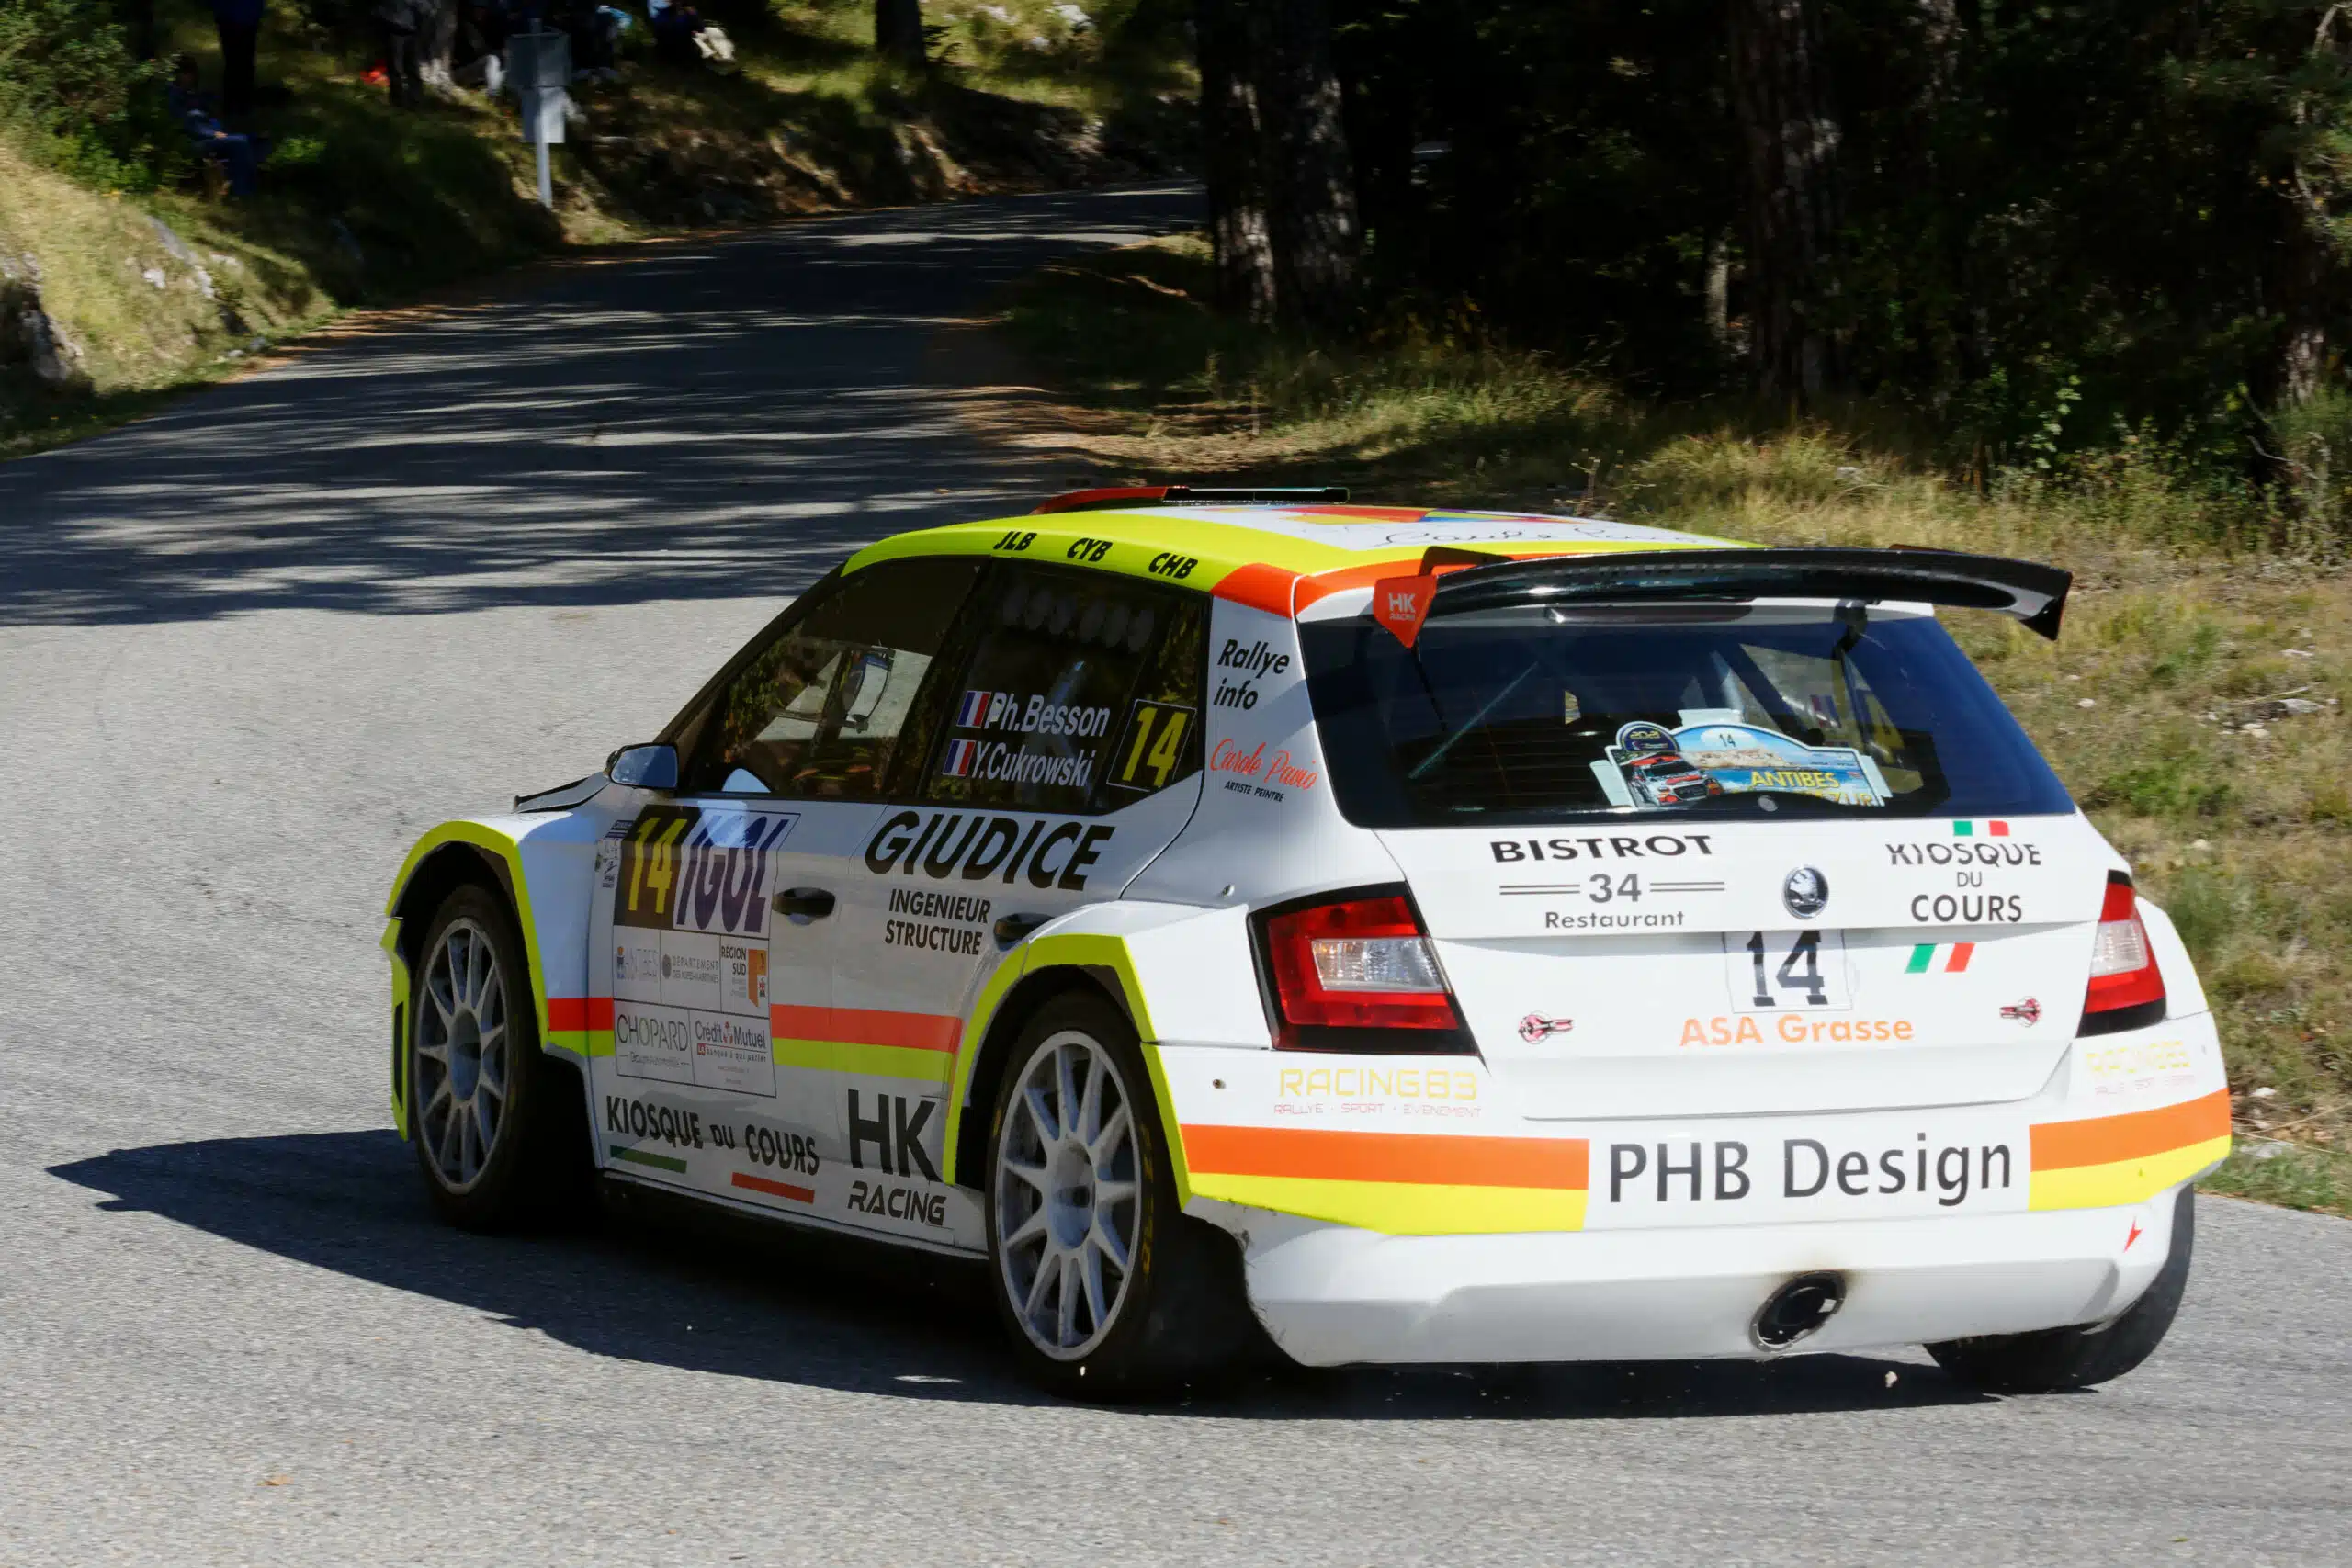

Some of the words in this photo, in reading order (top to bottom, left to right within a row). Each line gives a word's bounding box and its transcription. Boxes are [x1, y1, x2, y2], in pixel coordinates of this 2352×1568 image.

[993, 530, 1037, 551] JLB
[1066, 537, 1114, 562] CYB
[1148, 552, 1198, 579] CHB
[1388, 592, 1416, 613] HK
[1217, 639, 1290, 679] Rallye
[1213, 678, 1259, 710] info
[984, 692, 1111, 738] Ph.Besson
[1121, 705, 1188, 788] 14
[1210, 739, 1266, 776] Carole
[1719, 734, 1736, 747] 14
[970, 739, 1095, 788] Y.Cukrowski
[1750, 771, 1840, 788] ANTIBES
[1224, 781, 1252, 795] ARTISTE
[1254, 787, 1284, 802] PEINTRE
[628, 817, 688, 914] 14
[865, 810, 1115, 891] GIUDICE
[1491, 835, 1712, 863] BISTROT
[1886, 843, 2041, 867] KIOSQUE
[1589, 873, 1642, 903] 34
[1957, 872, 1983, 887] DU
[888, 888, 991, 924] INGENIEUR
[1545, 910, 1685, 929] Restaurant
[1911, 895, 2022, 922] COURS
[885, 919, 983, 955] STRUCTURE
[732, 963, 746, 976] SUD
[1747, 931, 1828, 1007] 14
[616, 1014, 688, 1052] CHOPARD
[695, 1020, 722, 1043] Crédit
[733, 1026, 766, 1049] Mutuel
[1679, 1017, 1763, 1045] ASA
[1778, 1014, 1914, 1043] Grasse
[606, 1095, 703, 1150] KIOSQUE
[709, 1124, 734, 1149] DU
[745, 1124, 820, 1175] COURS
[847, 1089, 943, 1183] HK
[1609, 1142, 1751, 1203] PHB
[1782, 1133, 2011, 1206] Design
[847, 1180, 946, 1225] RACING
